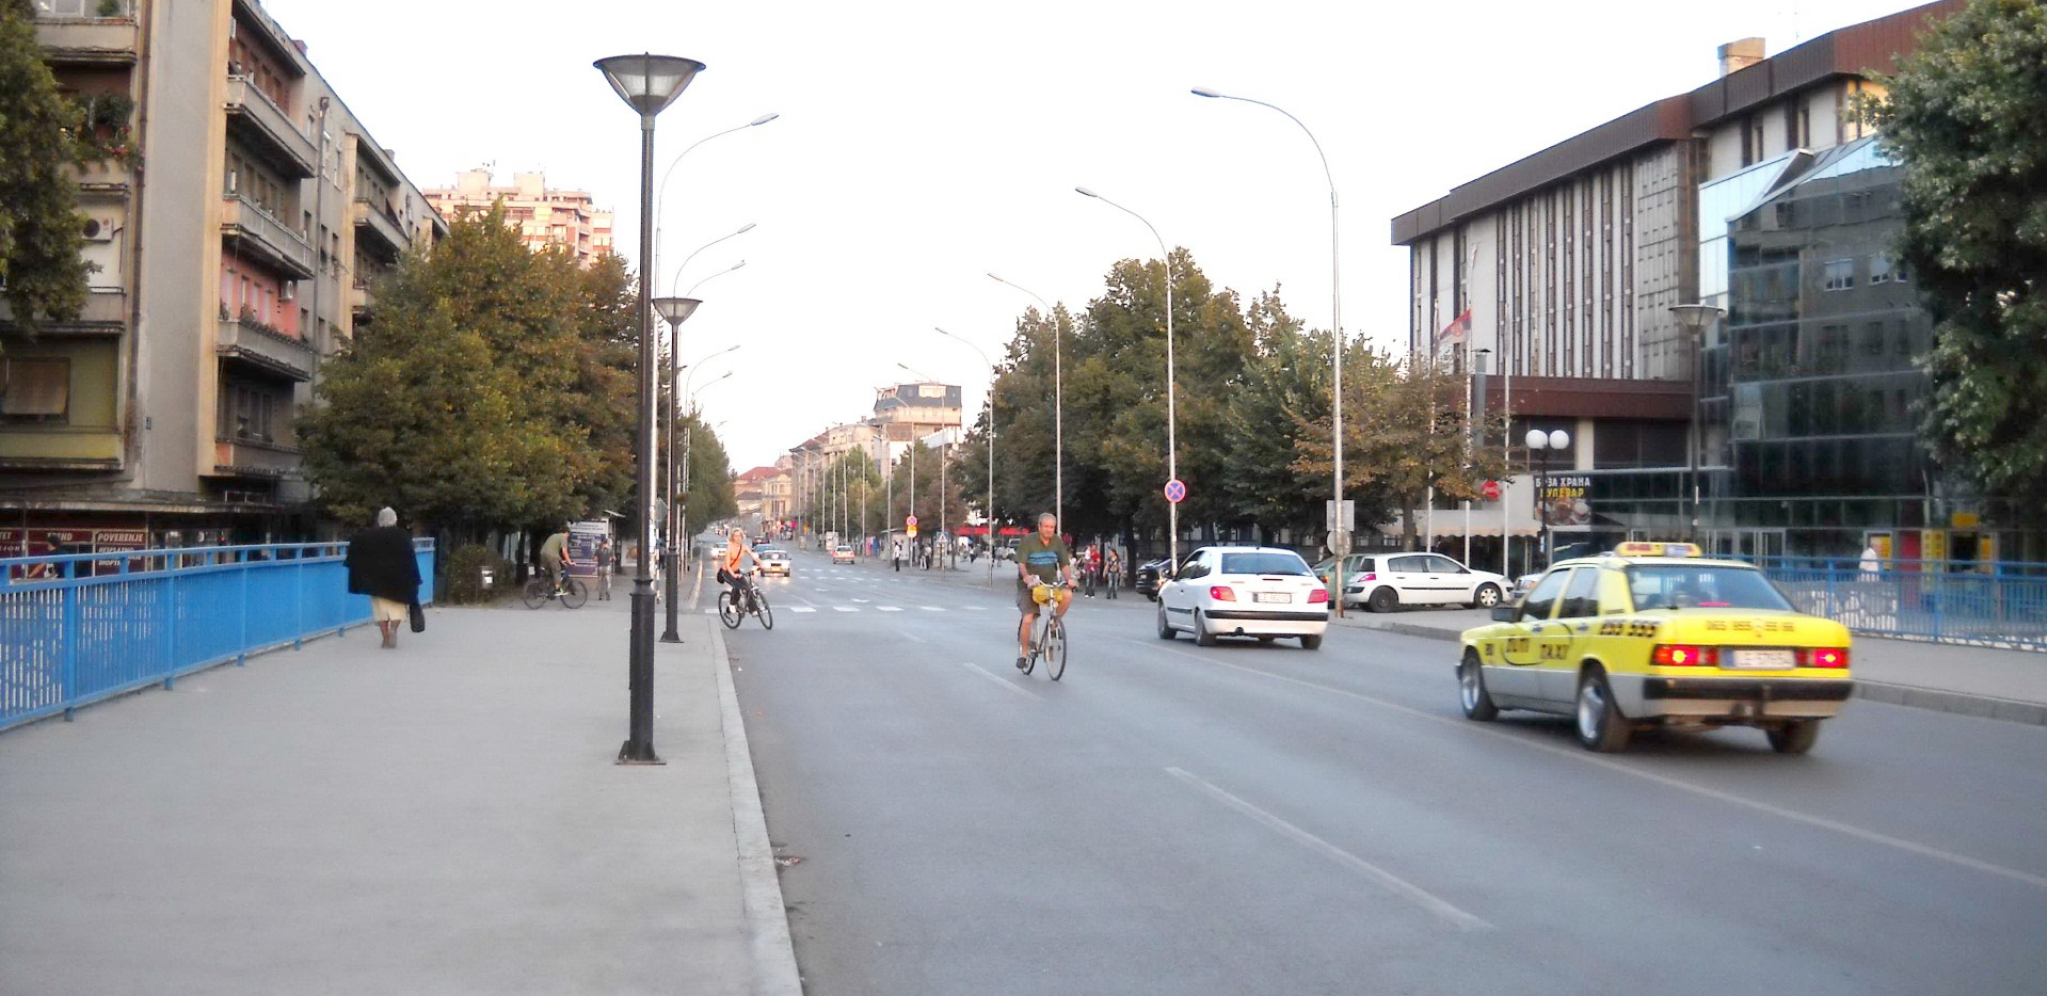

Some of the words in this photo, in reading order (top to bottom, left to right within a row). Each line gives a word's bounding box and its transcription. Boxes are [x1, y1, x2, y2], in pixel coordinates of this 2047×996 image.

[1535, 477, 1558, 488] БЗА
[1560, 476, 1591, 487] ХРАНА
[47, 532, 73, 541] TND
[97, 532, 144, 543] POVERENJE
